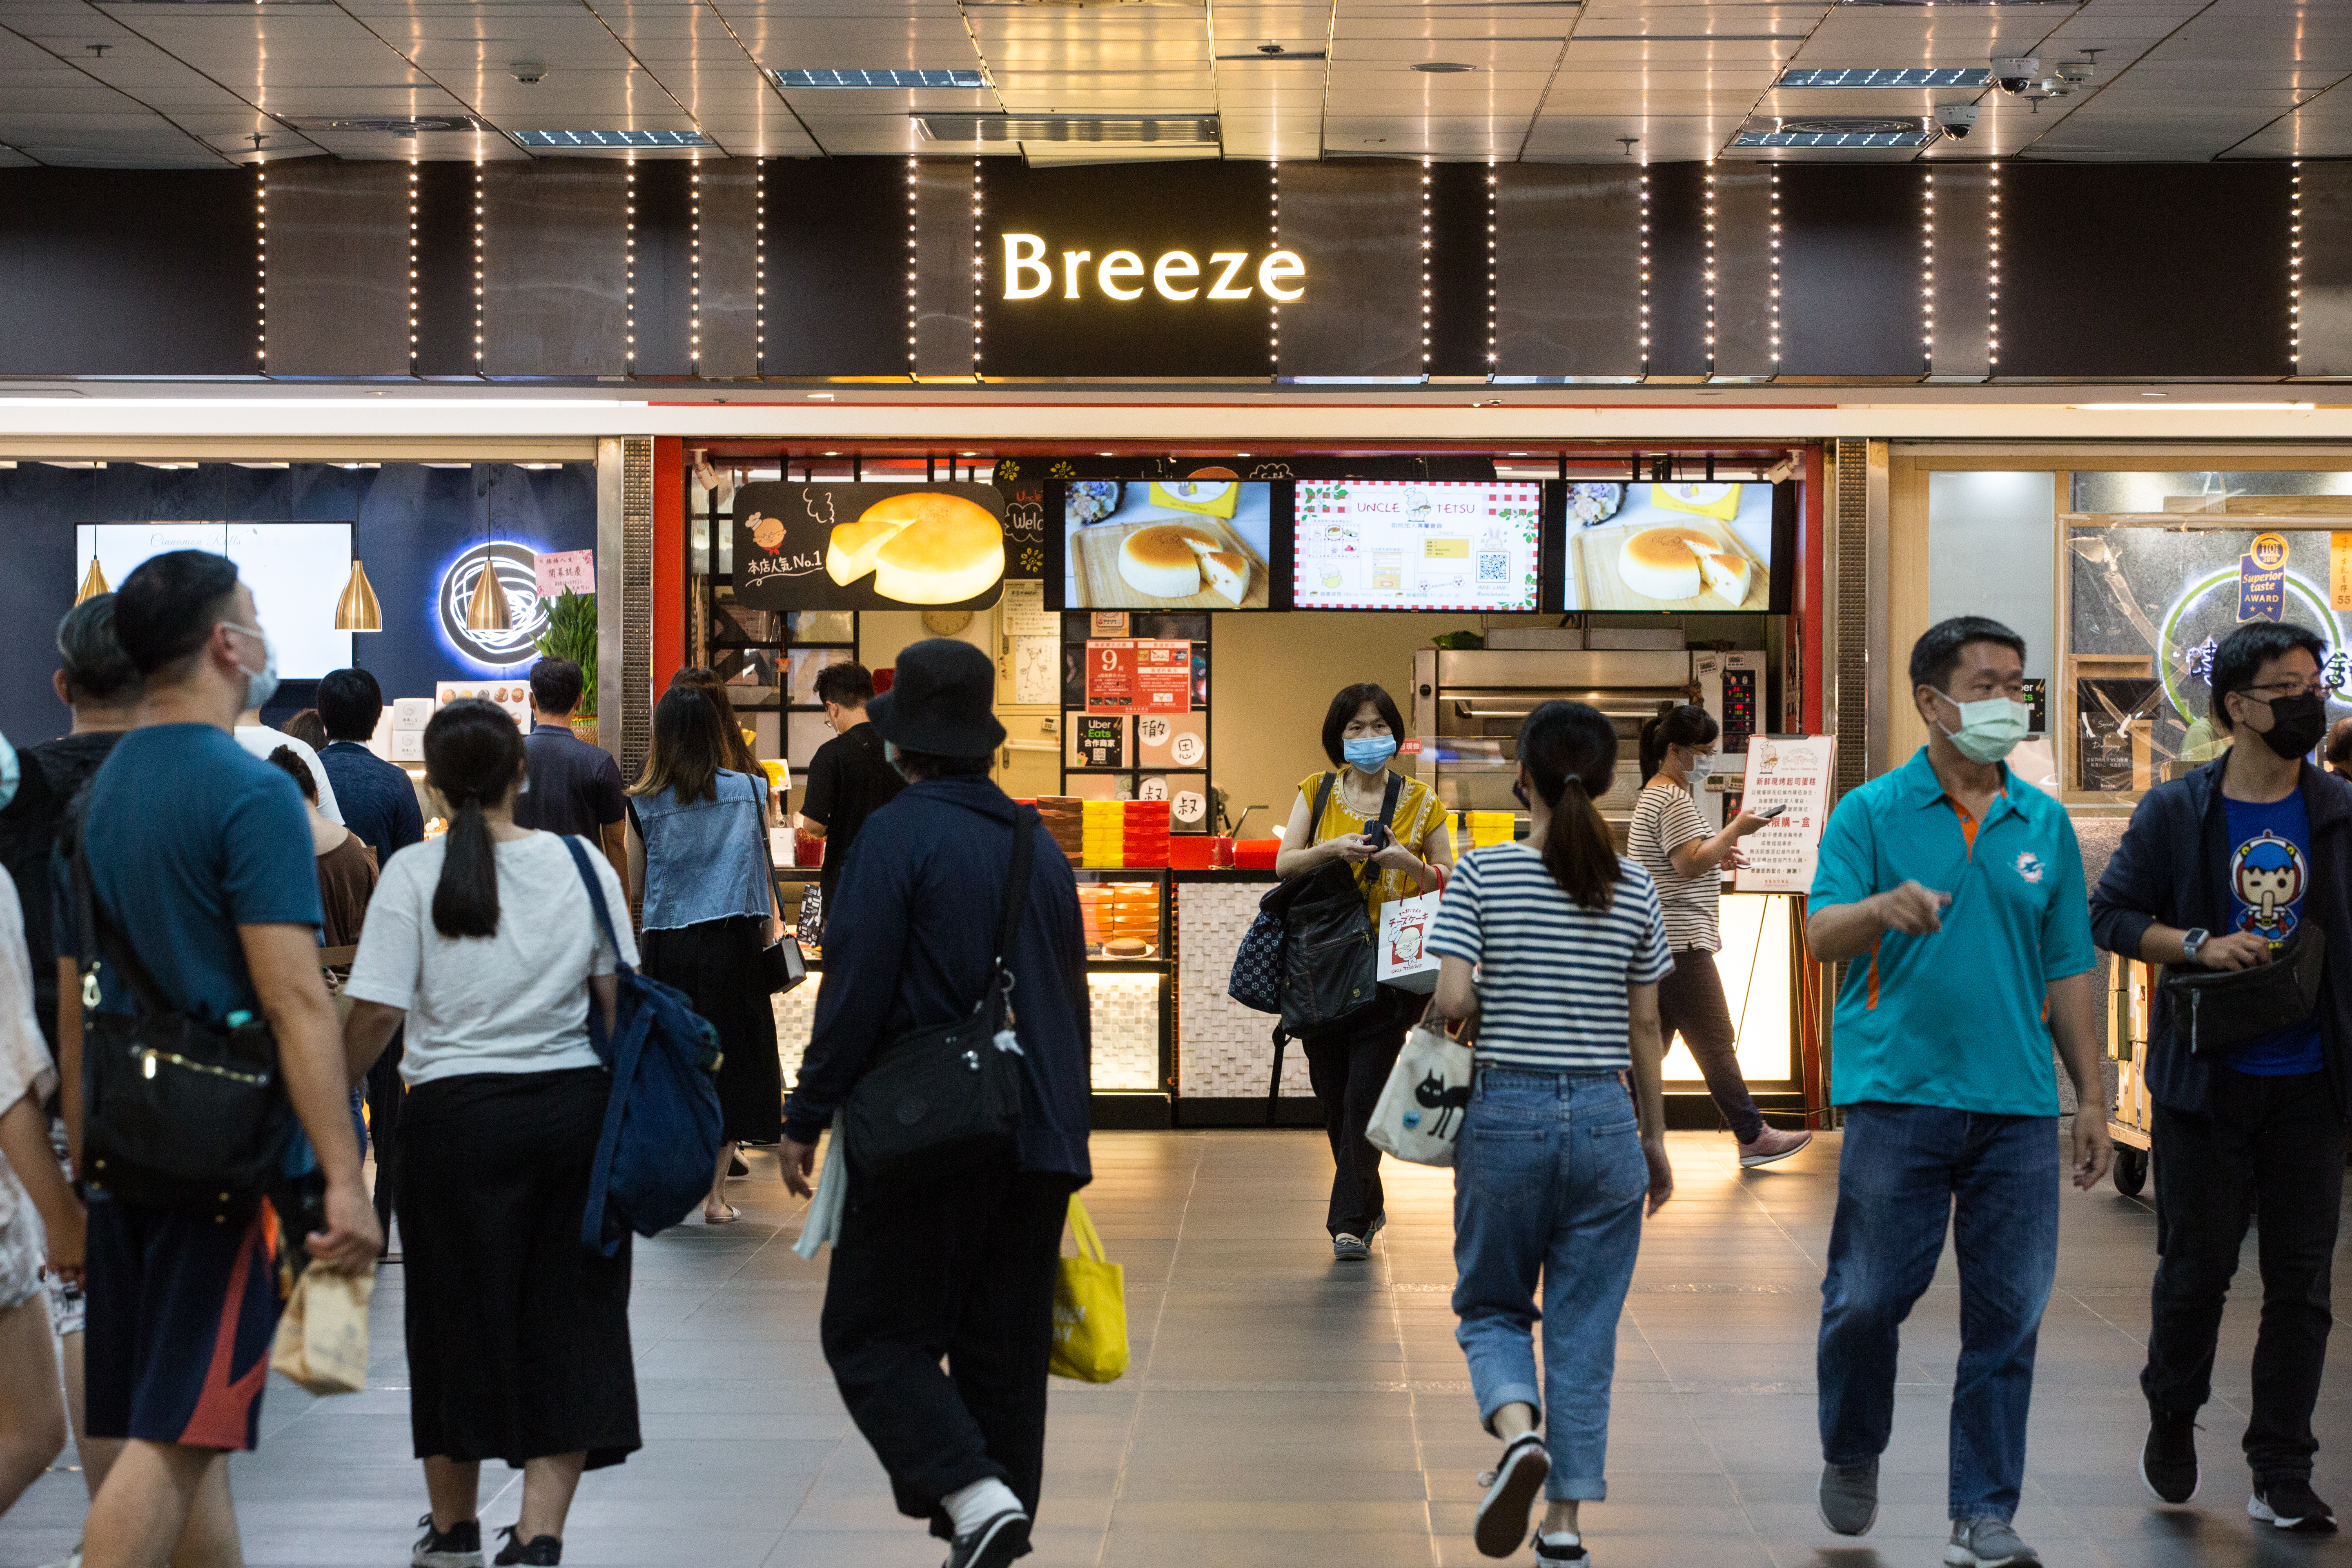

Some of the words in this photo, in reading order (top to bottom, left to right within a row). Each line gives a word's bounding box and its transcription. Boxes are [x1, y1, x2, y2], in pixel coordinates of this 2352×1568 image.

[1002, 233, 1305, 301] Breeze
[1357, 503, 1400, 512] UNCLE
[1436, 503, 1475, 514] TETSU
[150, 532, 202, 548] Cinnamon
[748, 557, 792, 575] 本店人気
[793, 551, 822, 568] No.1
[2242, 571, 2283, 584] Superior
[2250, 581, 2275, 592] taste
[2337, 595, 2351, 605] 55
[1088, 720, 1111, 729] Uber
[1088, 729, 1111, 737] Eats
[1084, 739, 1116, 748] 合作商家
[1756, 777, 1816, 786] 新鮮現烤起司蛋糕
[1178, 796, 1197, 815] 叔
[1766, 817, 1810, 828] 限購一盒
[1398, 908, 1421, 916] てつおじさんの
[1389, 912, 1429, 927] チーズケーキ
